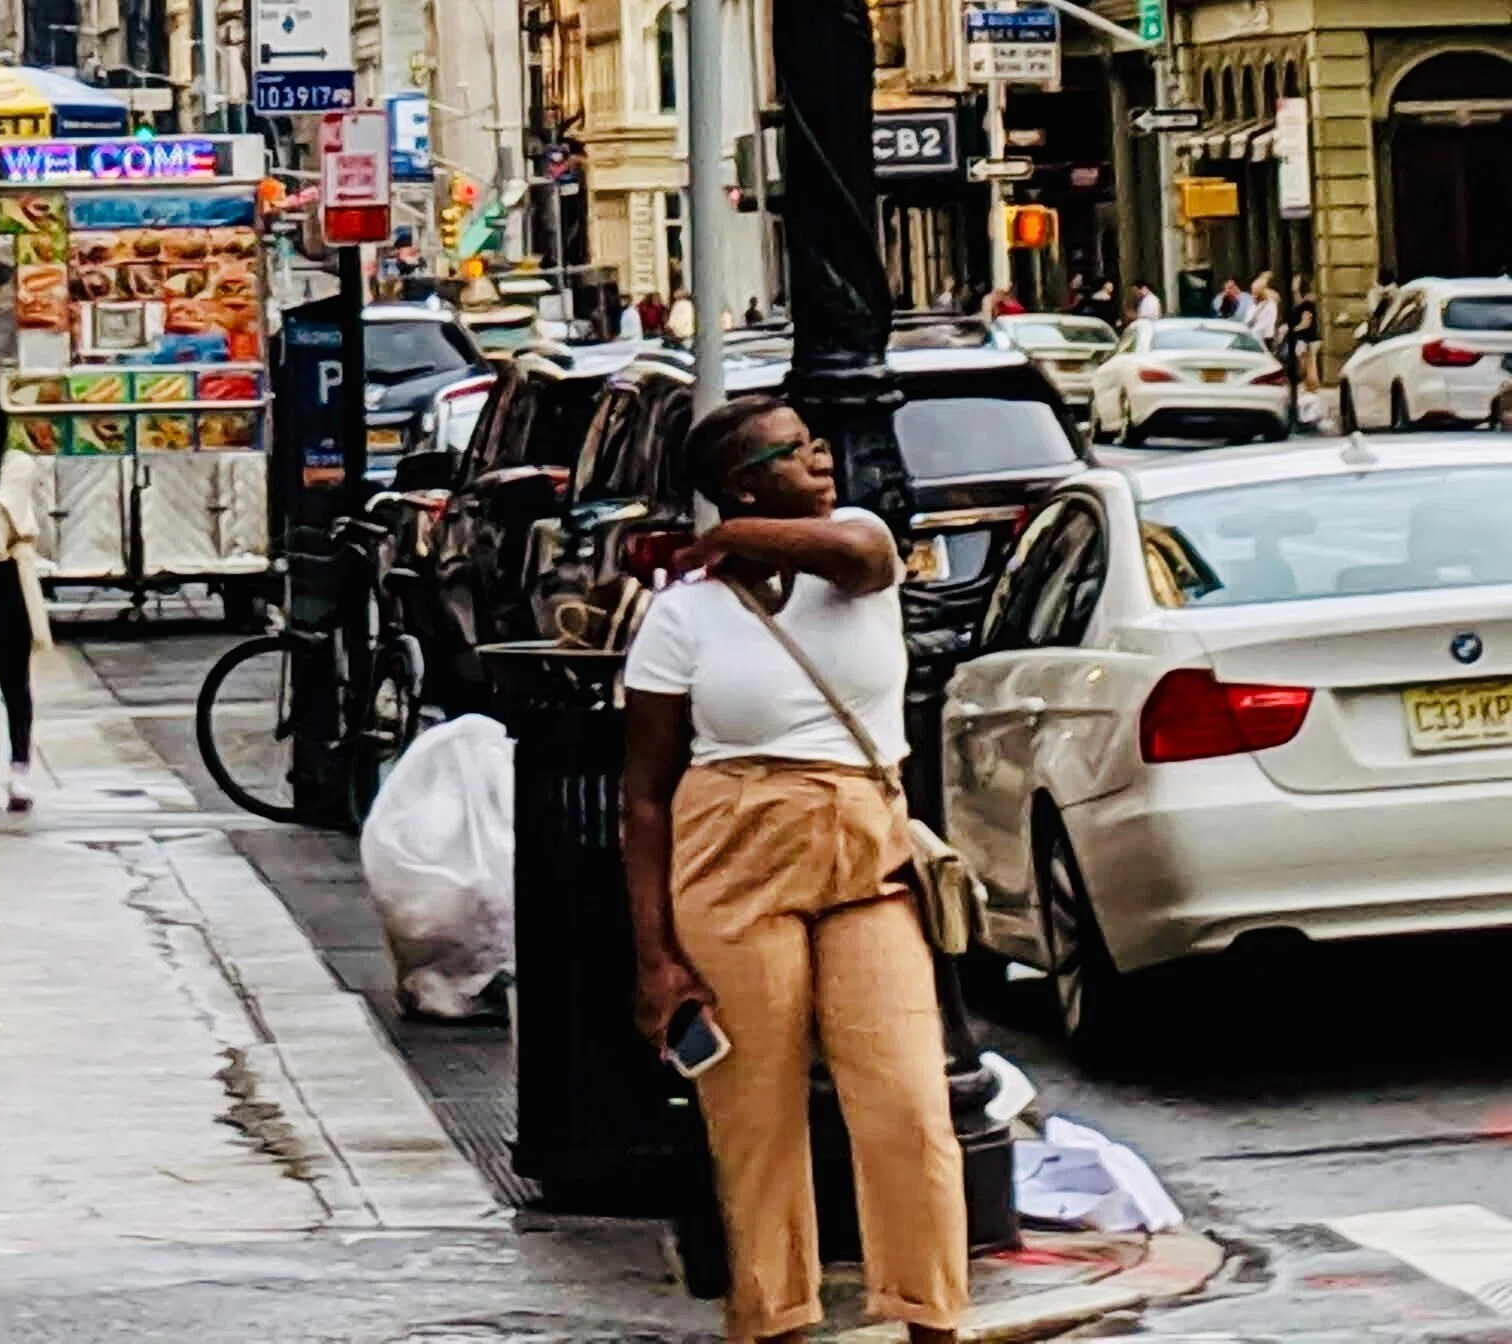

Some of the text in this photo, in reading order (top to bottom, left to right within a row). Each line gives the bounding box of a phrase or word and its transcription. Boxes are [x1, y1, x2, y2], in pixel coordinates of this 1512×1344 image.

[1, 140, 217, 182] WELCOME
[872, 127, 942, 160] CB2
[318, 360, 344, 405] P
